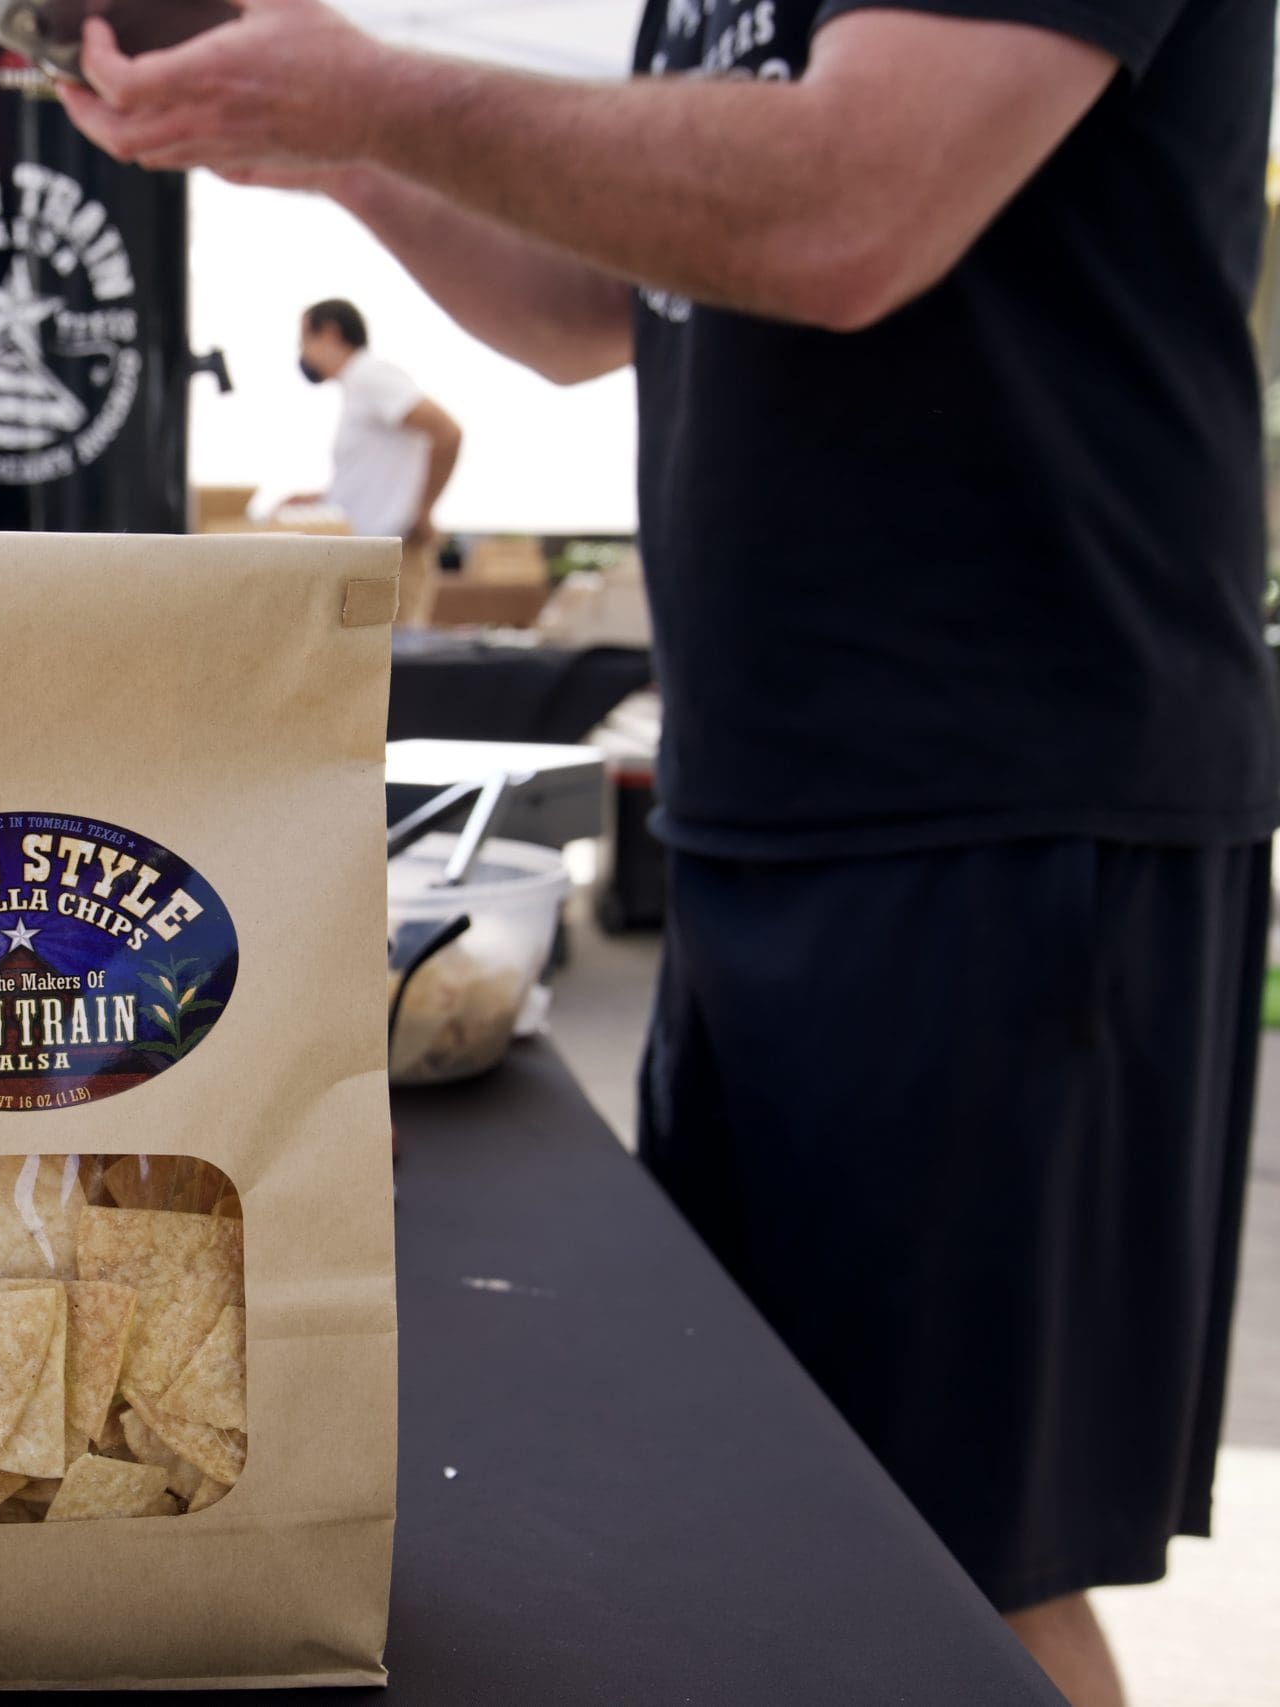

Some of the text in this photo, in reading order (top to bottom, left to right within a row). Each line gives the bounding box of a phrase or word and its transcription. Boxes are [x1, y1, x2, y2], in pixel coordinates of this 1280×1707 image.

[12, 161, 135, 300] TRAIN
[9, 816, 24, 829] IN
[27, 816, 83, 834] TOMBALL
[88, 824, 126, 846] TEXAS
[21, 833, 205, 943] STYLE
[57, 892, 150, 951] CHIPS
[21, 972, 81, 992] Makers
[87, 970, 107, 990] Of
[15, 994, 136, 1047] TRAIN
[18, 1094, 33, 1109] 16
[36, 1093, 52, 1108] OZ
[55, 1090, 67, 1106] (1
[70, 1085, 92, 1103] LB)
